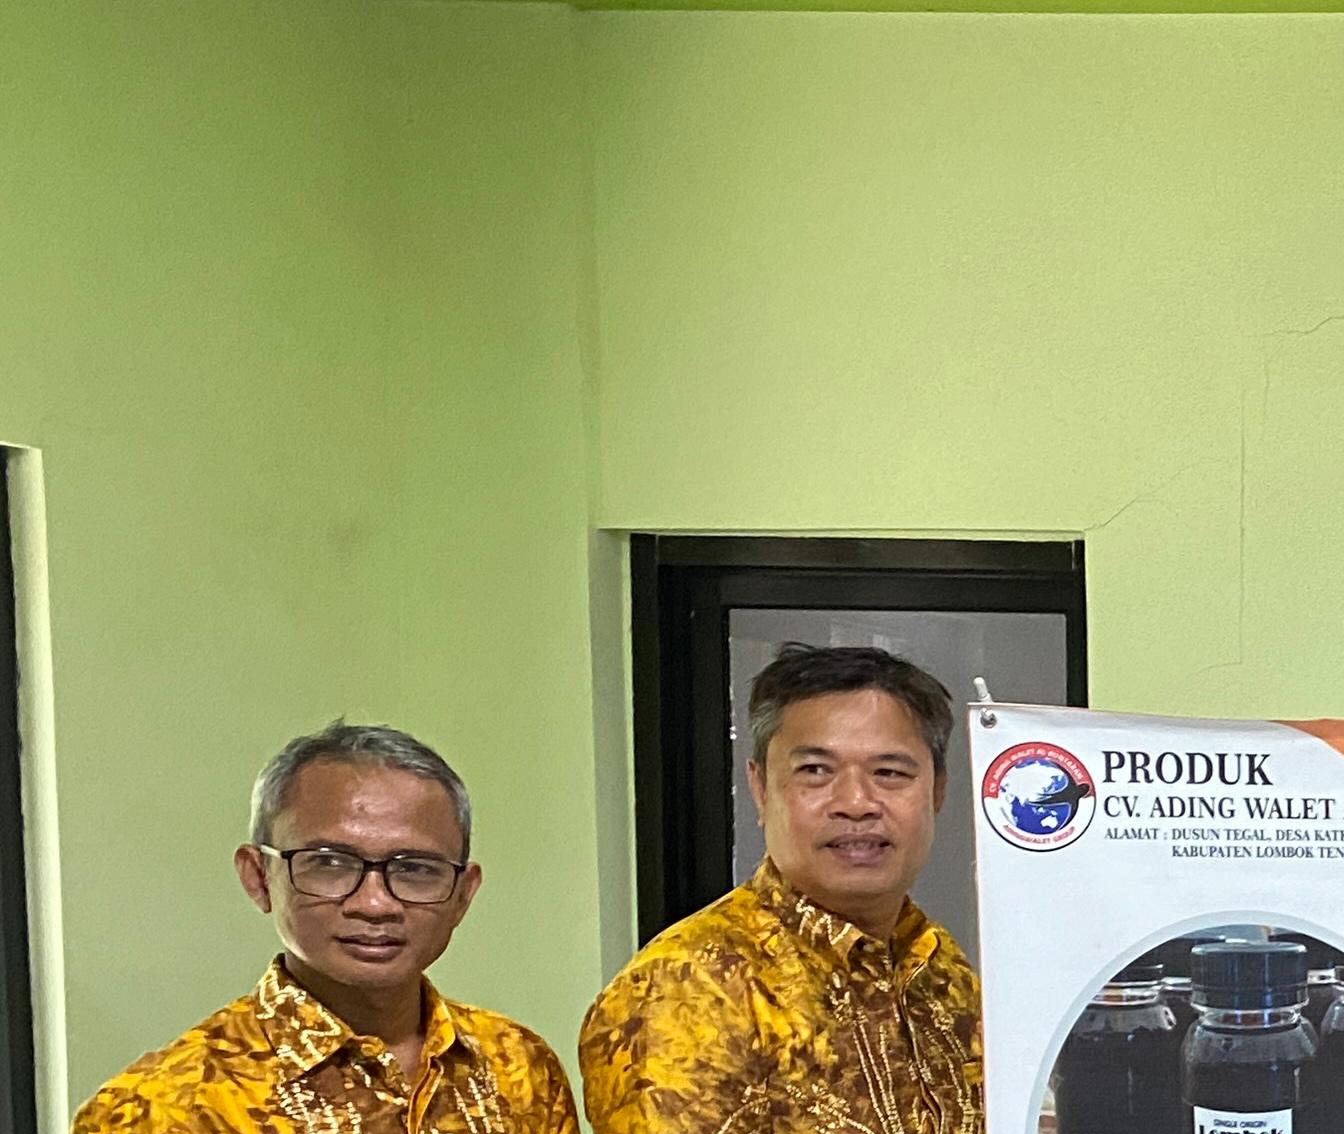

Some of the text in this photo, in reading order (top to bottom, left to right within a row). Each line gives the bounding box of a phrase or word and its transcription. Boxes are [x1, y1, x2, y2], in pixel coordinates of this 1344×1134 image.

[1102, 750, 1274, 786] PRODUK
[1104, 795, 1141, 818] CV.
[1150, 796, 1236, 819] ADING
[1243, 797, 1336, 820] WALET
[1104, 827, 1159, 840] ALAMAT
[1172, 828, 1220, 841] DUSUN
[1224, 829, 1273, 843] TEGAL,
[1275, 829, 1311, 841] DESA
[1172, 845, 1252, 858] KABUPATEN
[1256, 846, 1315, 858] LOMBOK
